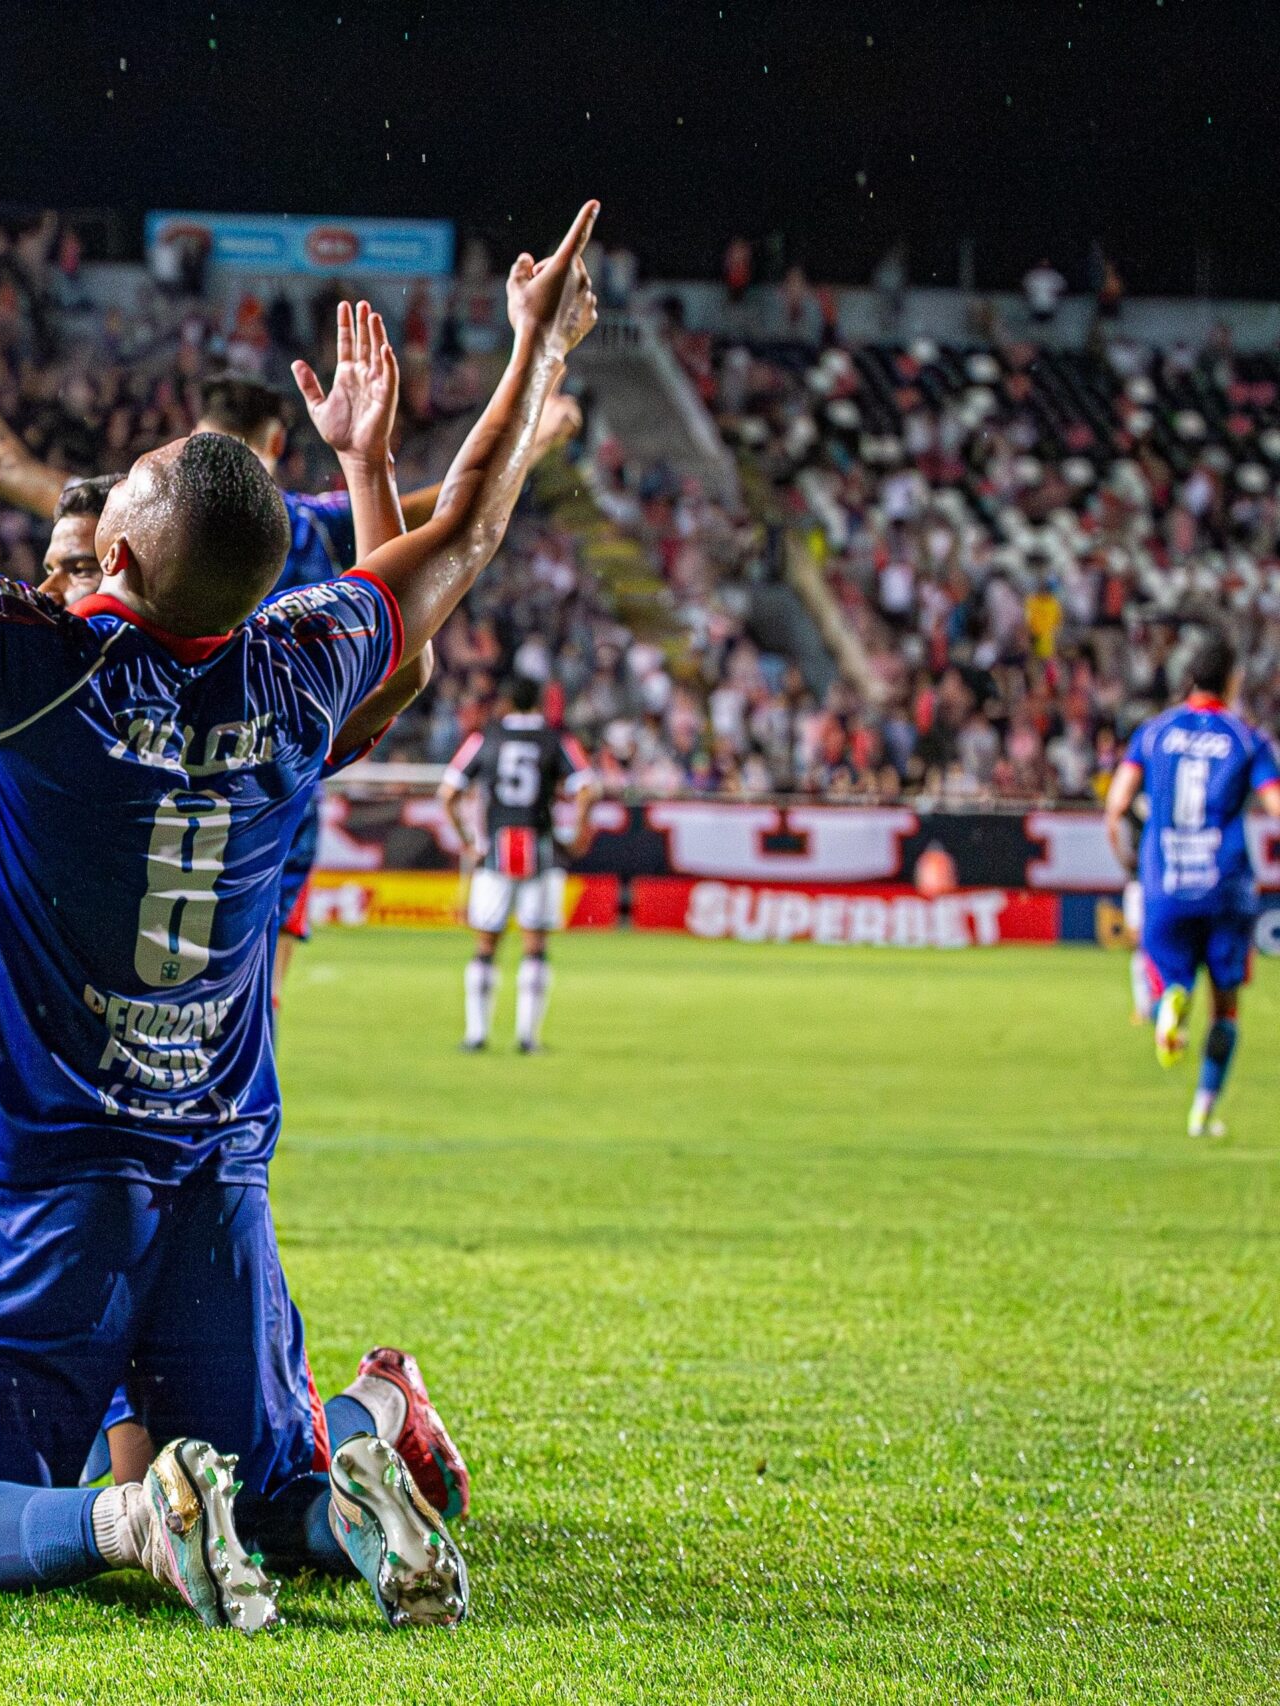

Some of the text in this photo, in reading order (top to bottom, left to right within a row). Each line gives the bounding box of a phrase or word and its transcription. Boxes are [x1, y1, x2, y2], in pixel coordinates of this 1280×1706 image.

[494, 740, 541, 806] 5
[134, 788, 232, 987] 8
[684, 881, 1007, 948] SUPERBET
